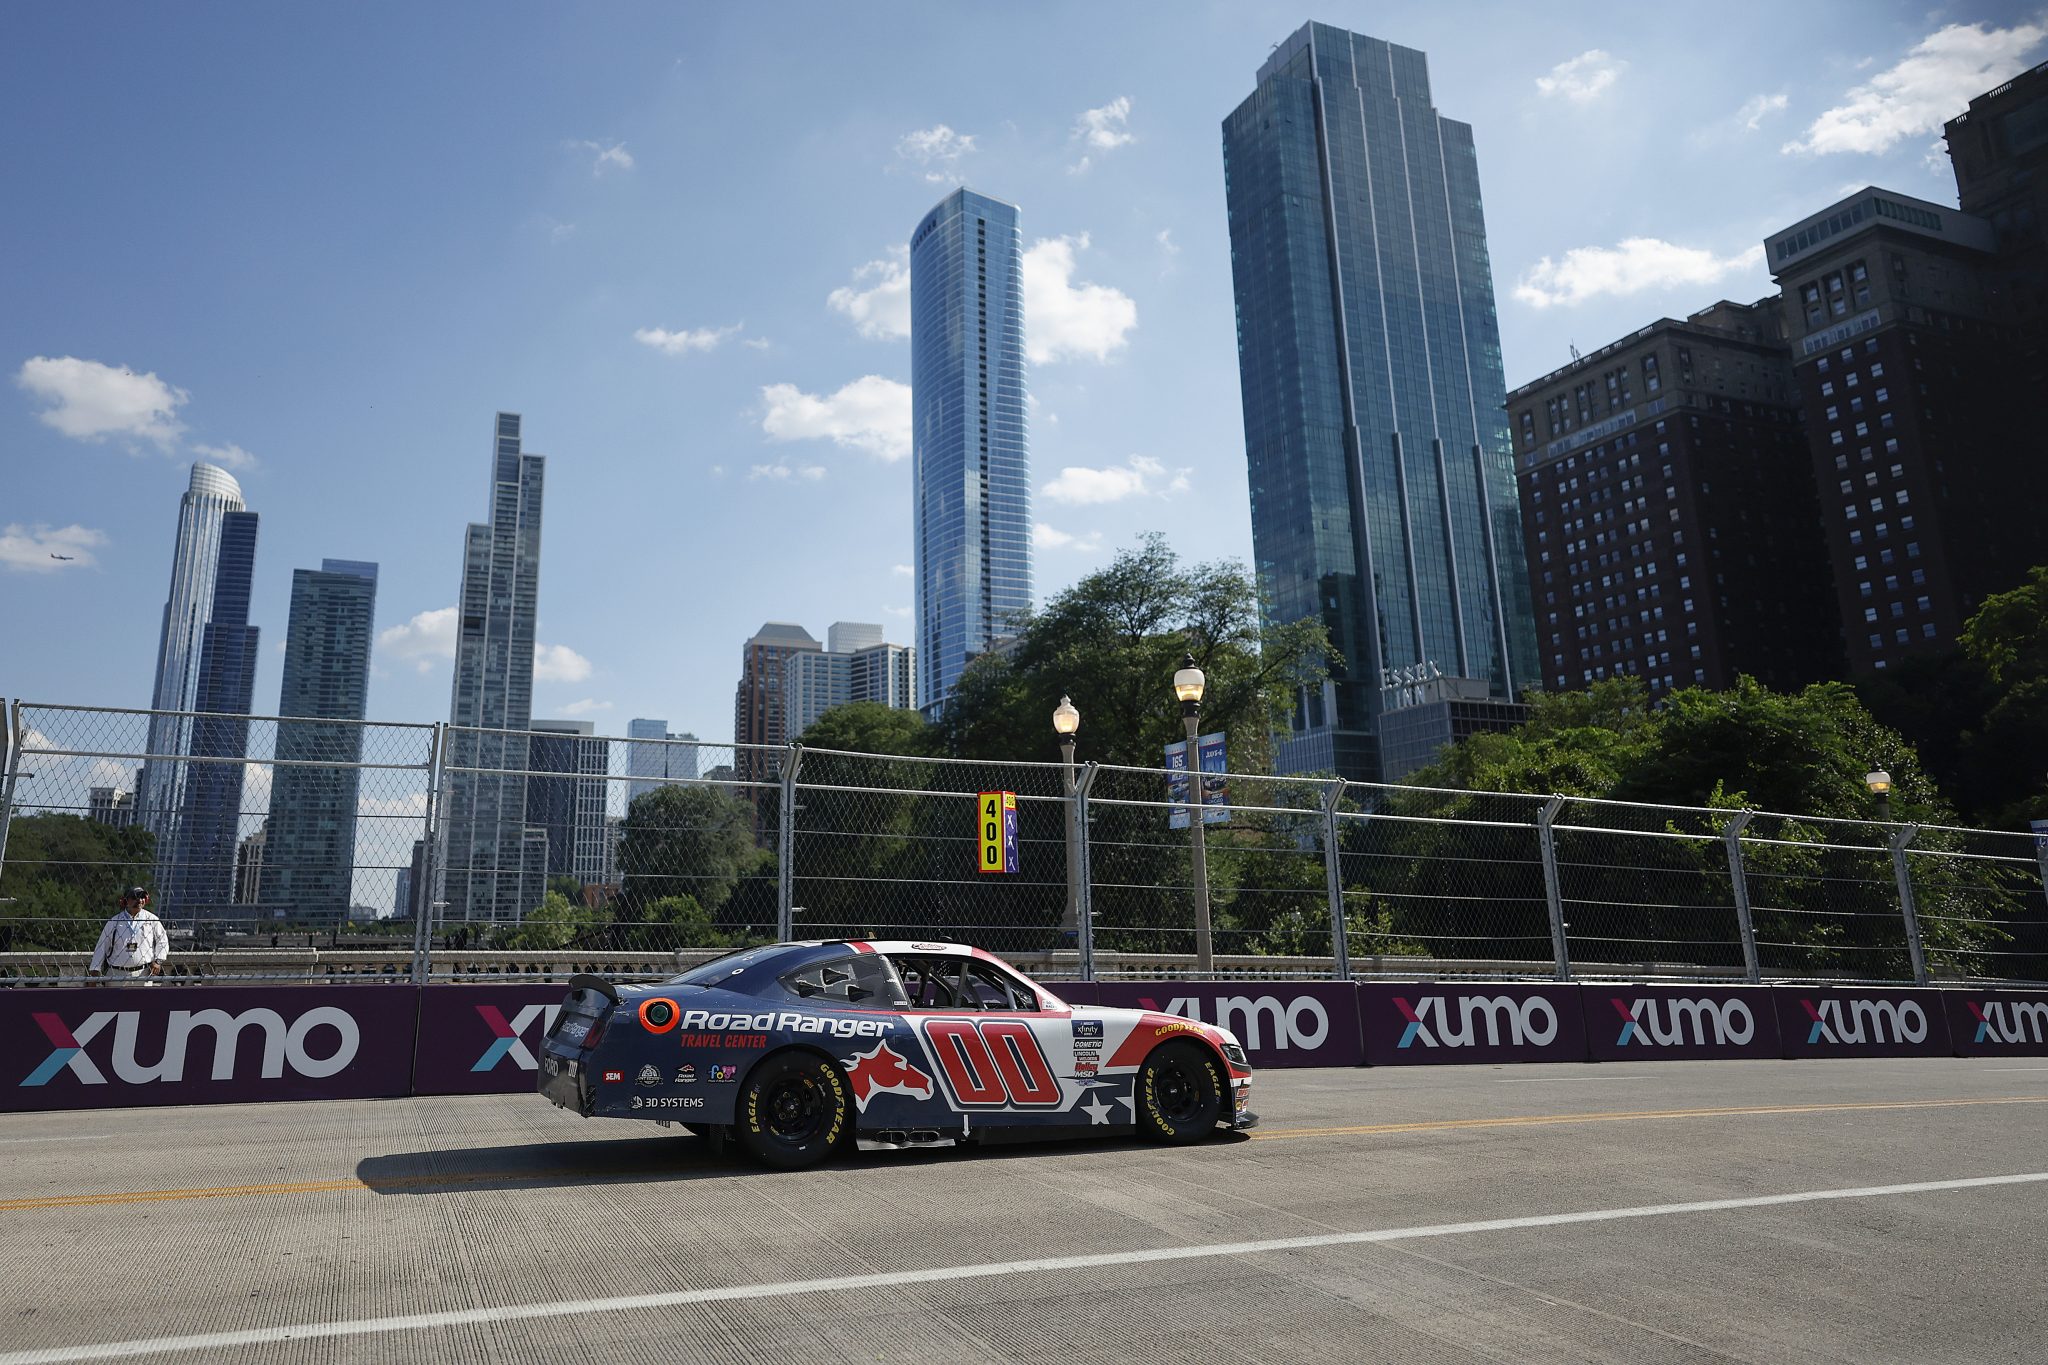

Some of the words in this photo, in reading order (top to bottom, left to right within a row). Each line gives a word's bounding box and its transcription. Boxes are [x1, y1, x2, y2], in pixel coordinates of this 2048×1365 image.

[681, 1034, 721, 1048] TRAVEL
[724, 1035, 767, 1048] CENTER
[544, 1058, 559, 1076] FORD
[605, 1072, 621, 1081] SEM
[1204, 1061, 1222, 1098] EAGLE
[645, 1098, 659, 1108] 3D
[660, 1098, 704, 1108] SYSTEMS
[748, 1090, 761, 1133] EAGLE
